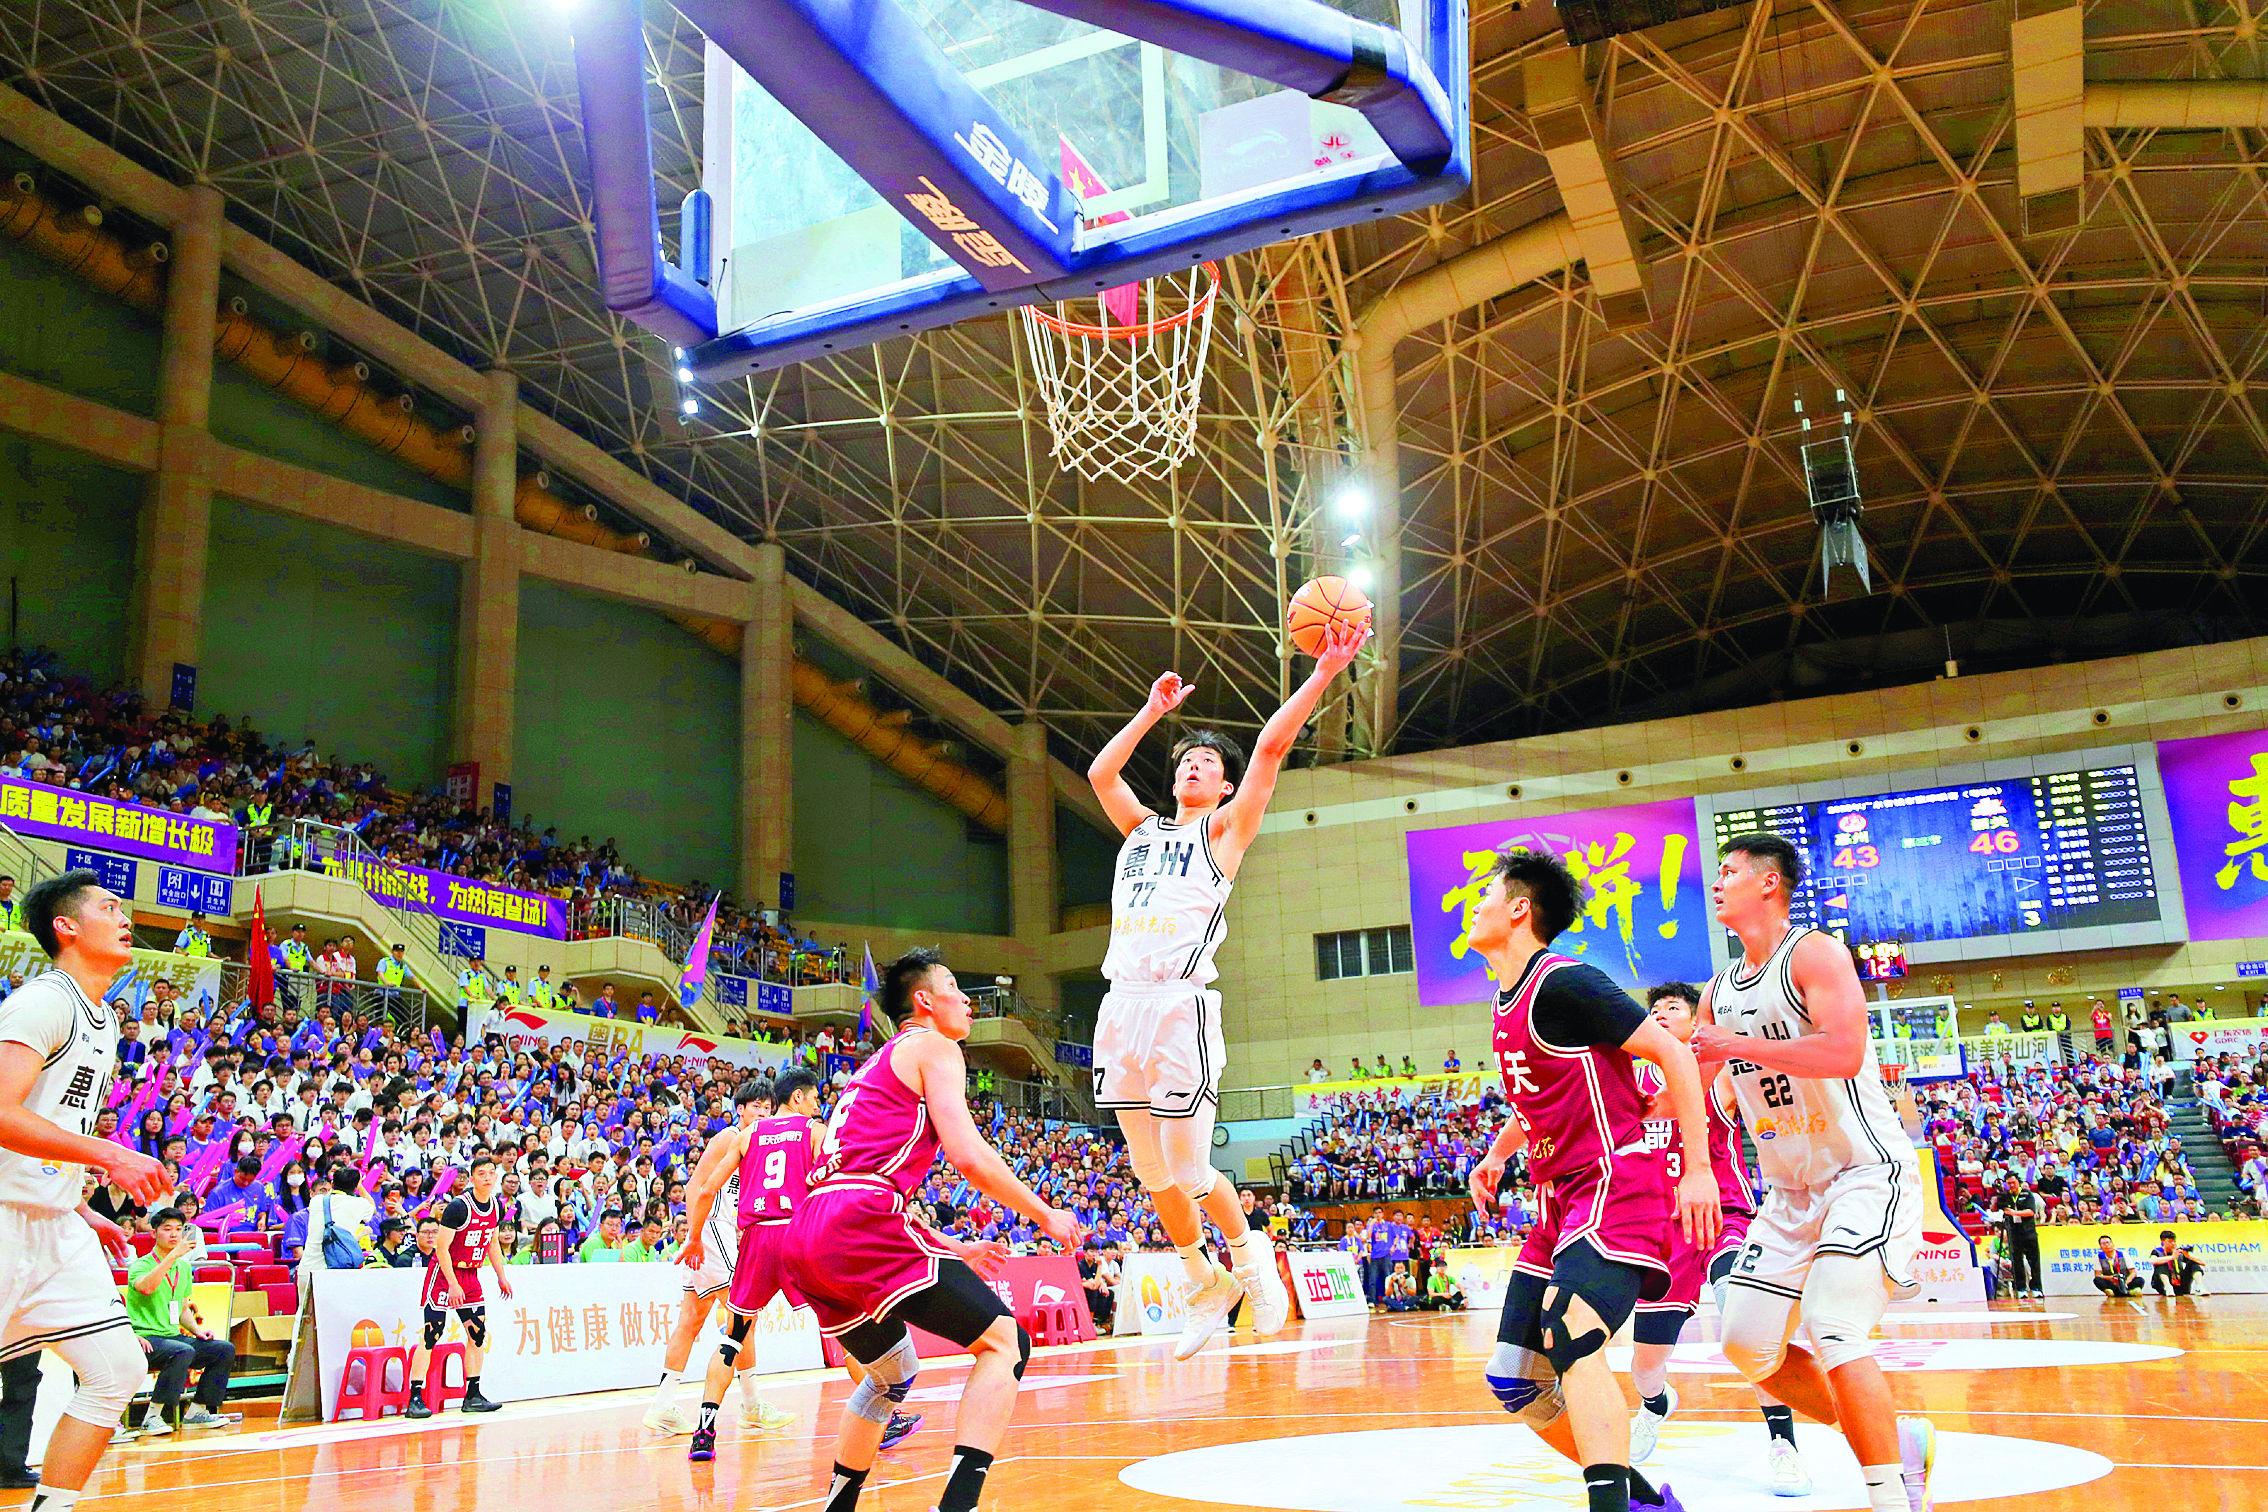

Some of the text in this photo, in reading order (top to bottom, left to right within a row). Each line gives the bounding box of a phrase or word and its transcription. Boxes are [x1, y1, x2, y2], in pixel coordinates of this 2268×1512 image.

[0, 784, 214, 855] 质量发展新增长极
[1969, 830, 2020, 855] 46
[75, 853, 92, 865] 十区
[106, 859, 130, 872] 十一区
[1121, 841, 1195, 881] 惠州
[1833, 845, 1881, 869] 43
[162, 889, 186, 900] 安全出口
[206, 896, 226, 906] 卫生间
[1128, 881, 1158, 908] 77
[2024, 910, 2042, 926] 3
[0, 940, 201, 1000] 城市联赛
[1869, 956, 1891, 977] 12
[1493, 1050, 1540, 1095] 关
[1759, 1073, 1794, 1109] 22
[762, 1149, 787, 1190] 9
[471, 1247, 484, 1261] 21
[513, 1302, 611, 1356] 为健康
